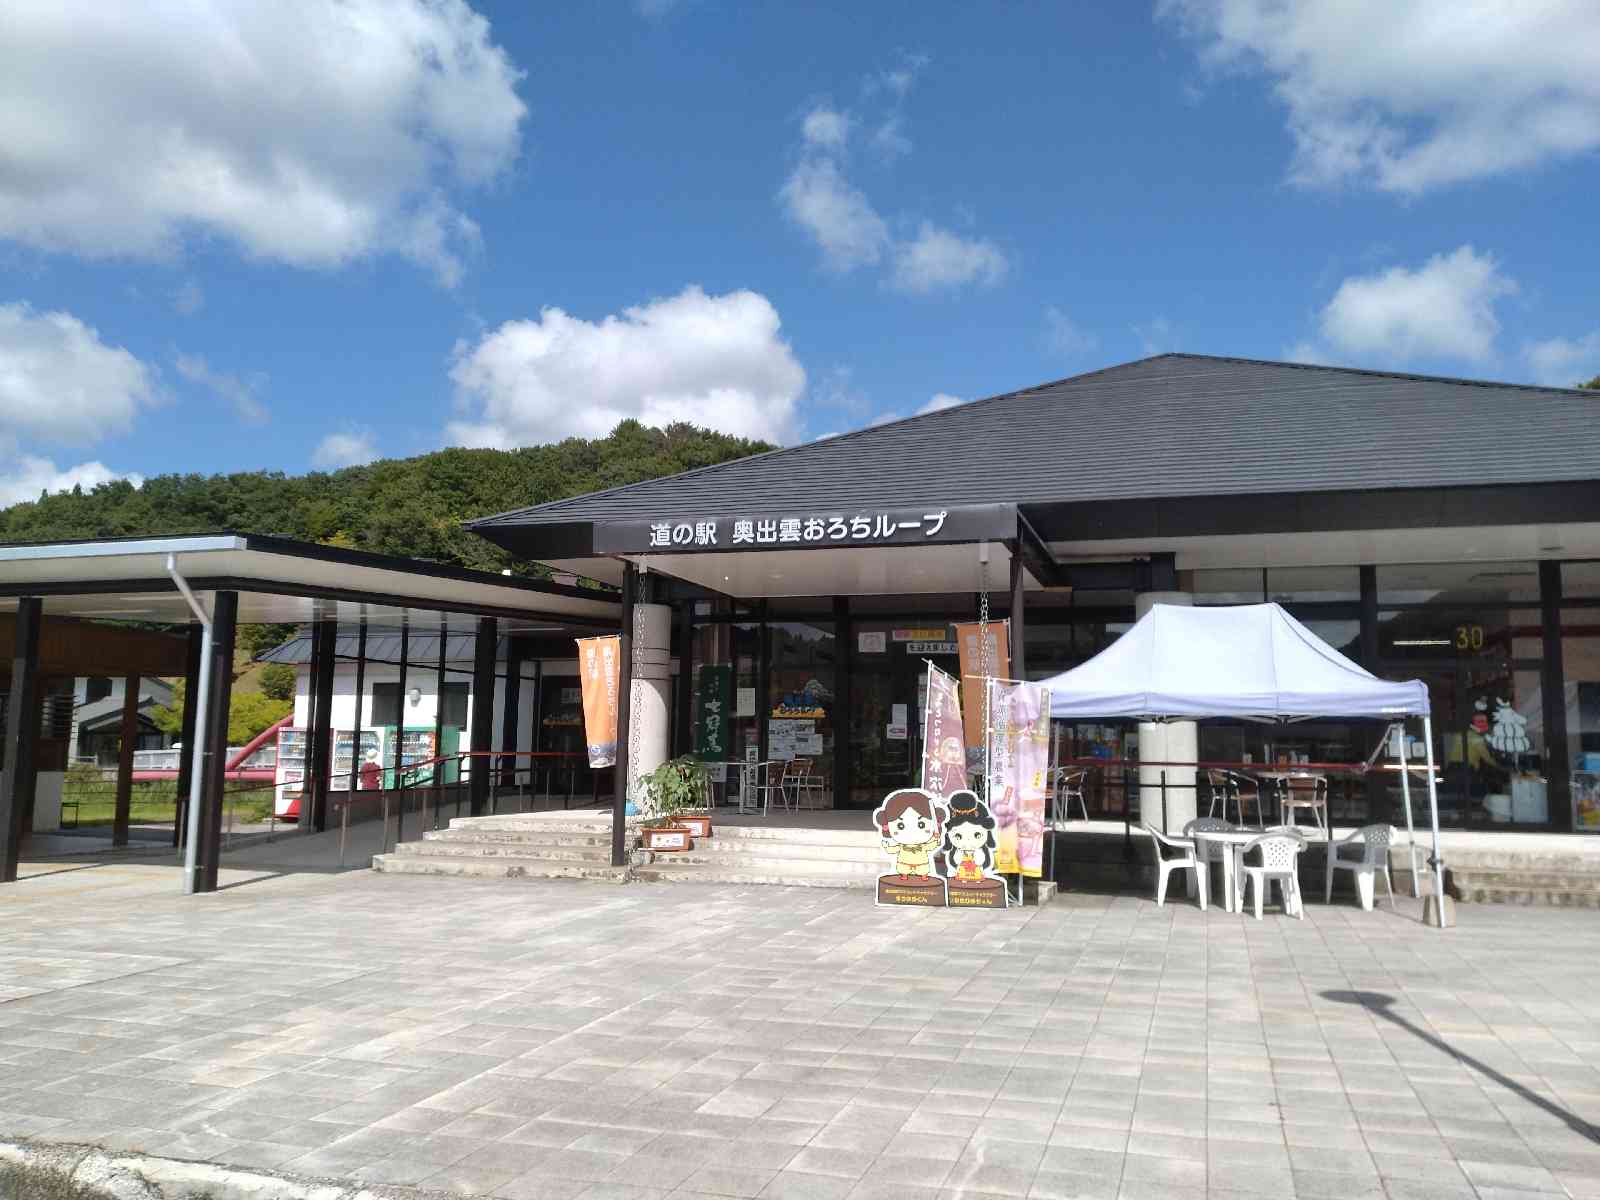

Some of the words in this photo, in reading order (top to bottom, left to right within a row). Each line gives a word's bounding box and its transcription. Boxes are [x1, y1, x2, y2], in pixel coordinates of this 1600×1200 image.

[650, 522, 717, 547] 道の駅
[732, 511, 948, 543] 奥出雲おろちループ
[1456, 625, 1483, 649] 30
